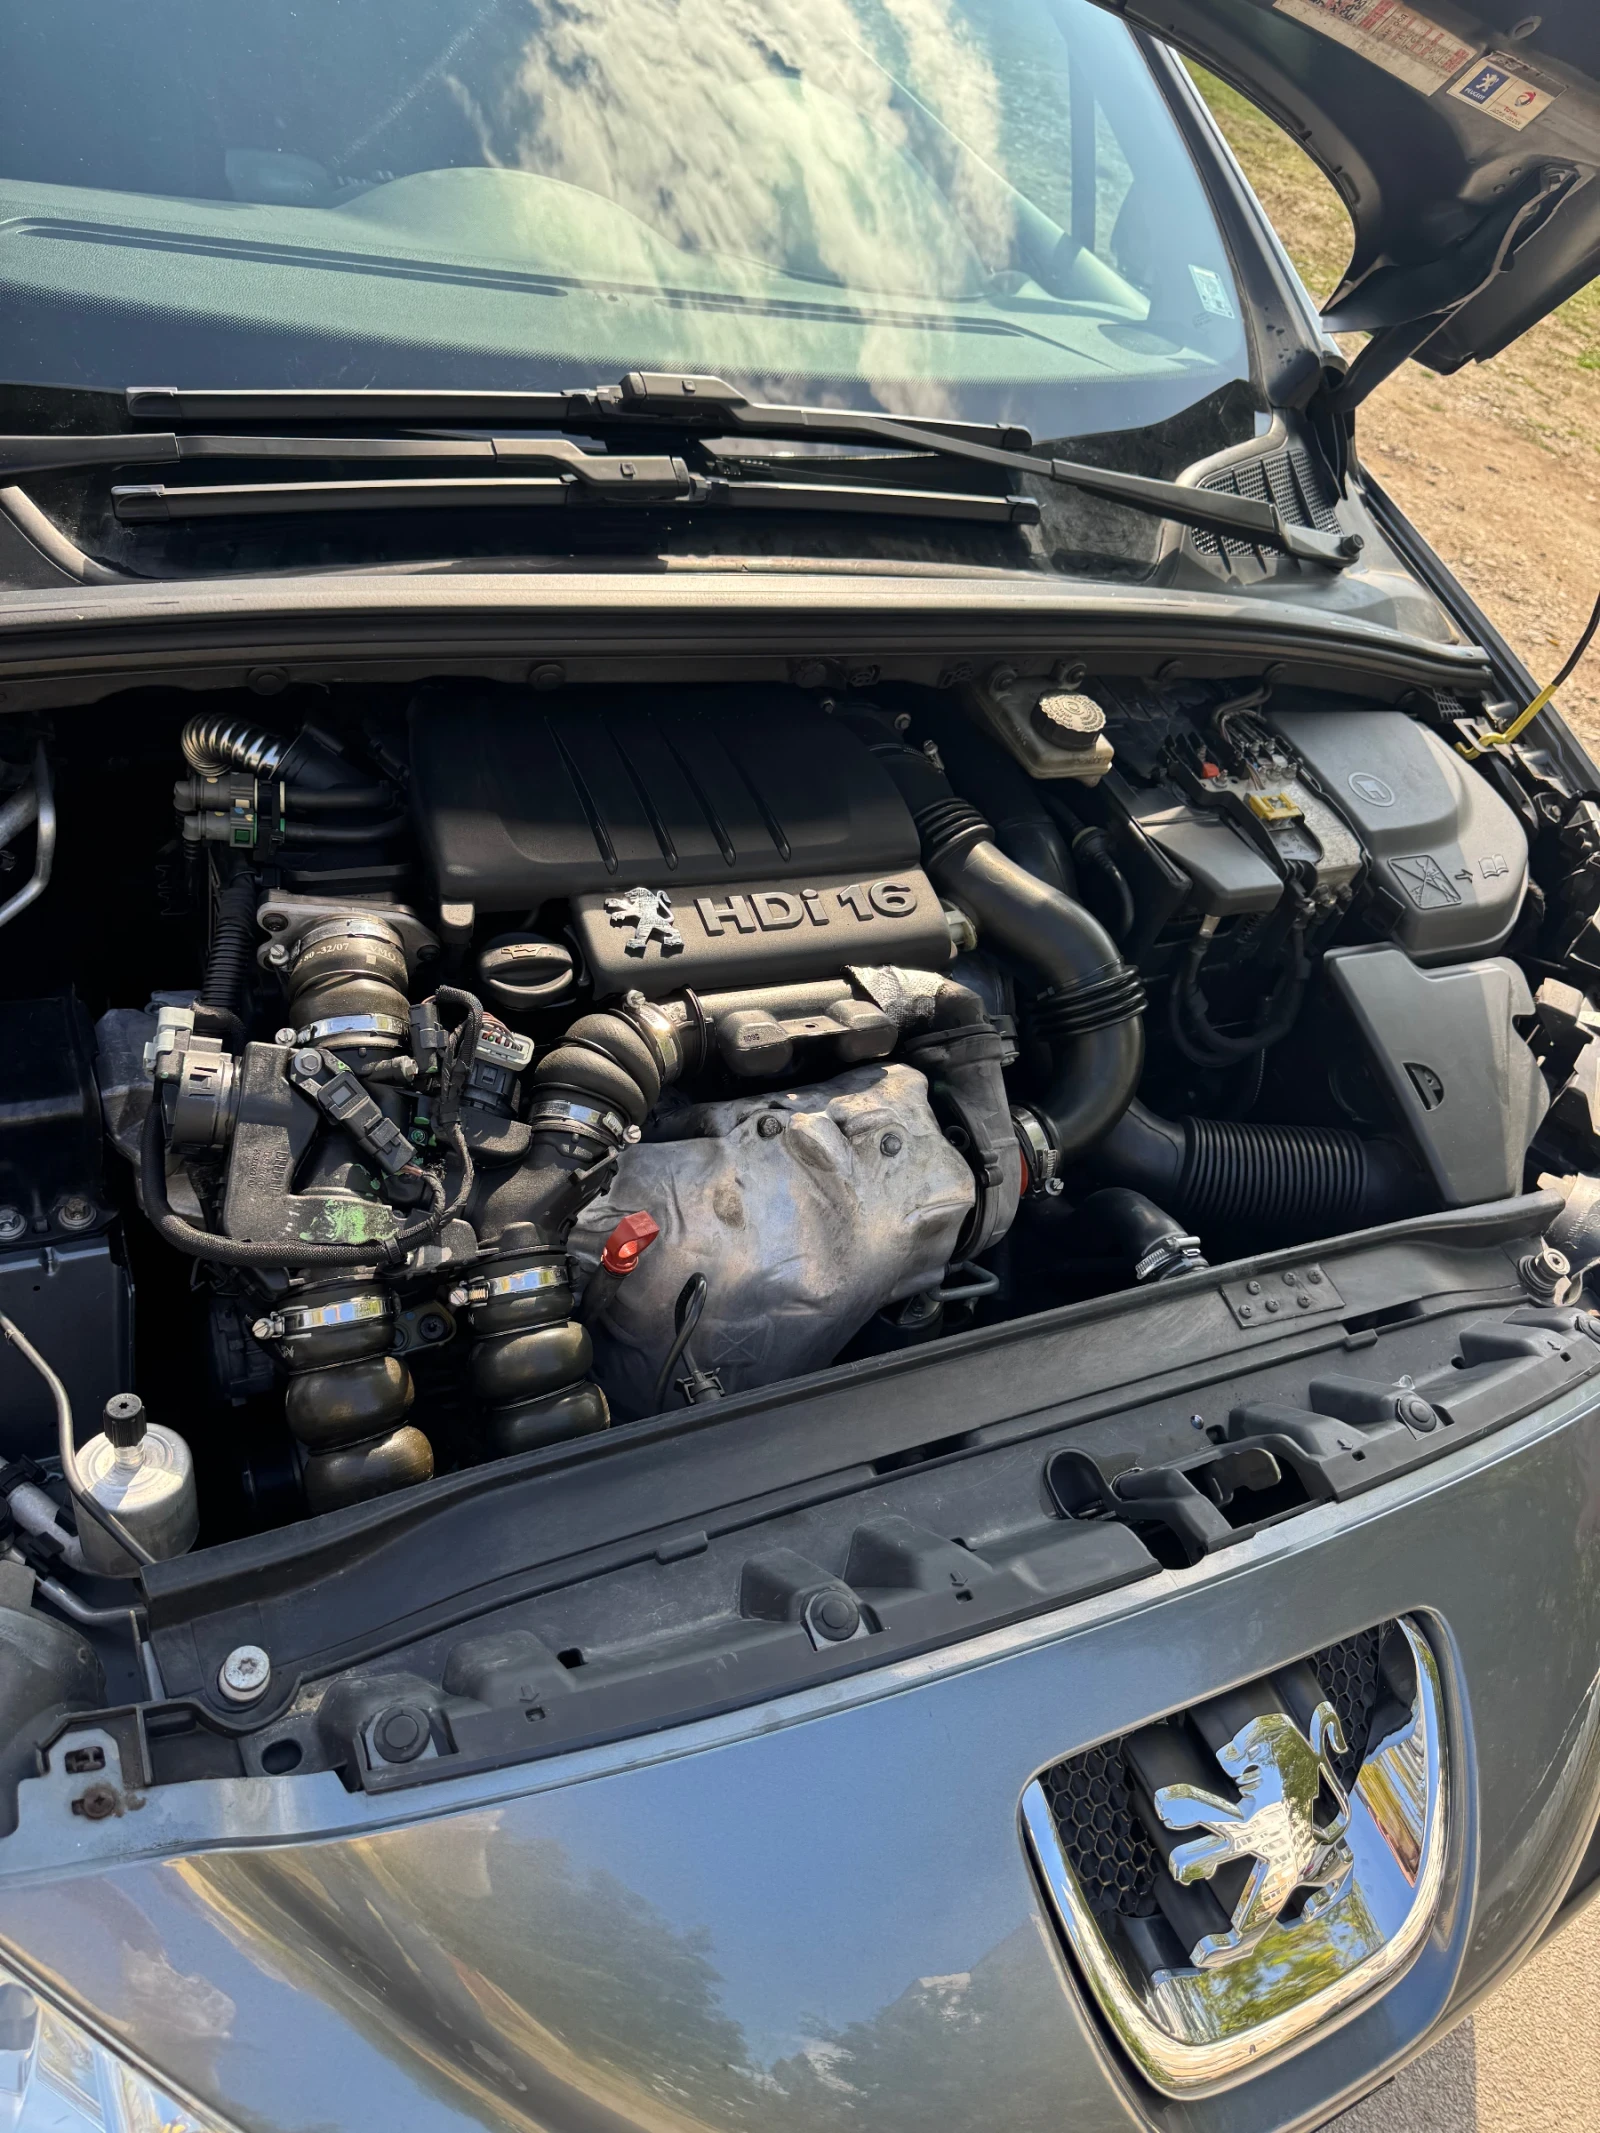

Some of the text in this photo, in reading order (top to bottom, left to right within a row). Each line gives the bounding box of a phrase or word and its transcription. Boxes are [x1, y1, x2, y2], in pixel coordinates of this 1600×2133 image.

[1464, 87, 1486, 101] PEUGEOT
[1503, 105, 1519, 117] TOTAL
[695, 881, 918, 936] HDi 16
